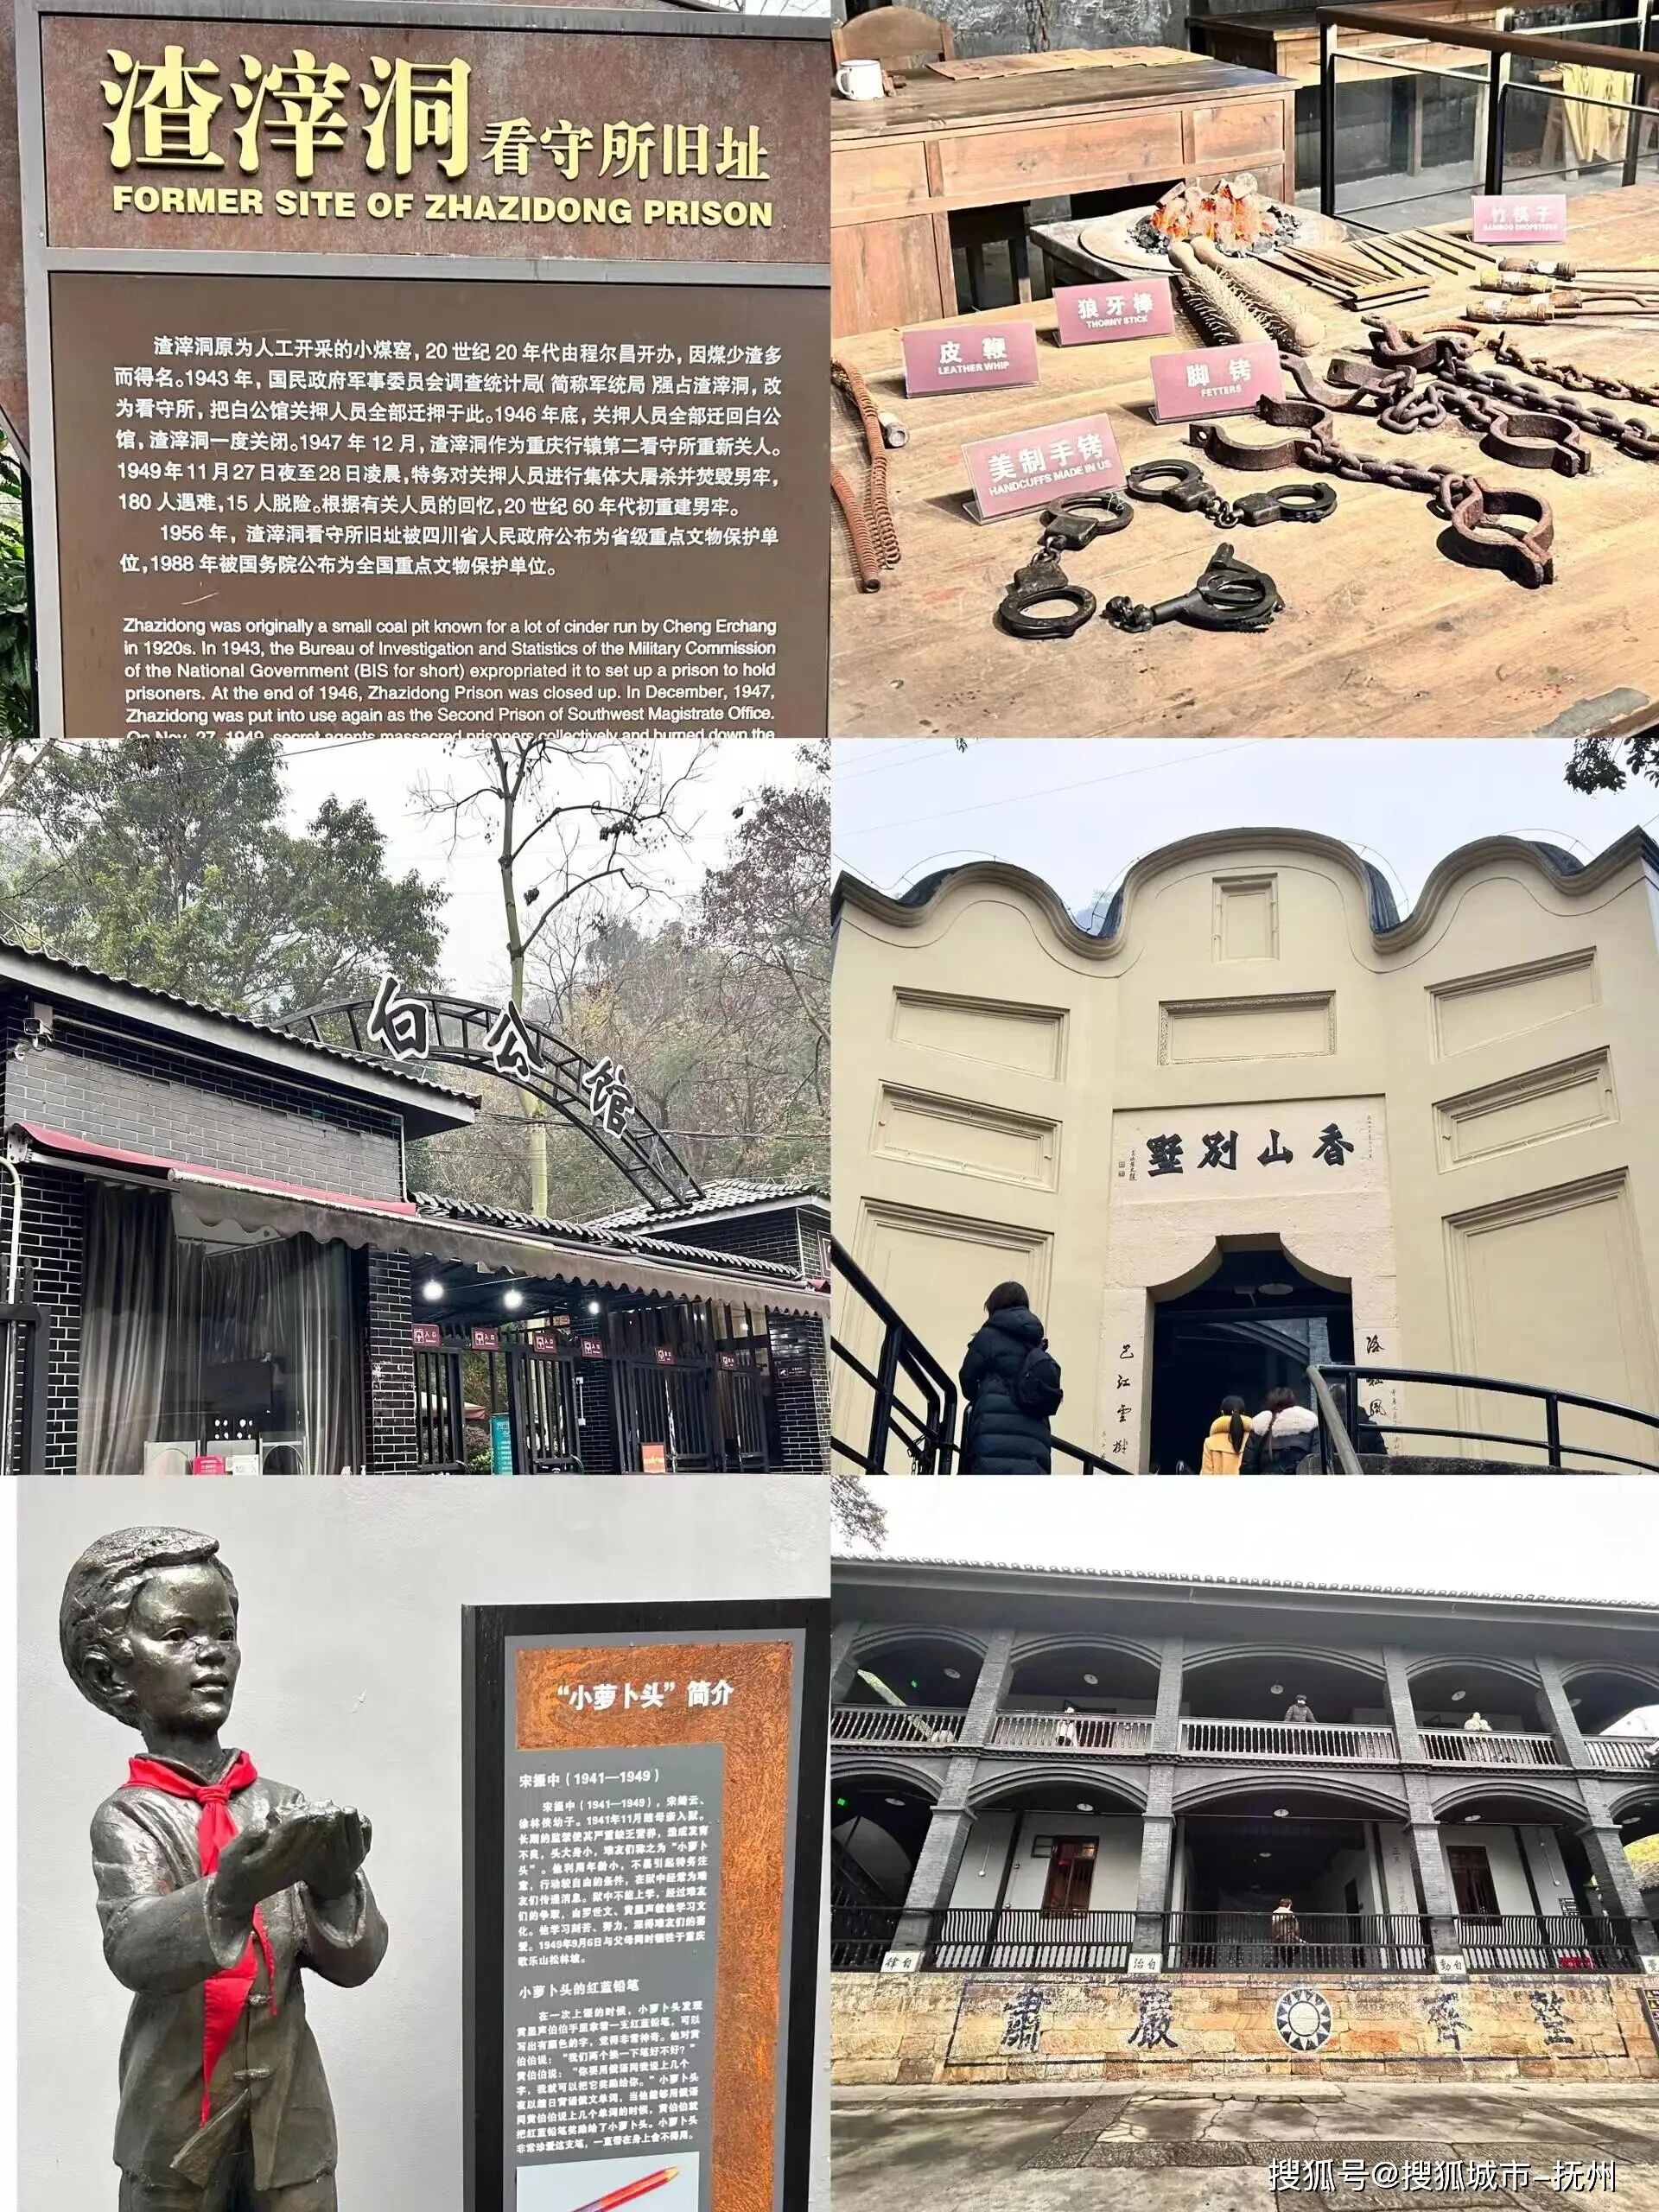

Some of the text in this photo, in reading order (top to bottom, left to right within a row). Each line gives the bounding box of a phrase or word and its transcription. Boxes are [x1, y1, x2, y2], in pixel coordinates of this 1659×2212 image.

[99, 44, 771, 181] 渣滓洞 看守所旧址
[113, 185, 773, 228] FORMER SITE OF ZHAZIDONG PRISON
[1078, 292, 1154, 319] 狼牙棒
[1086, 315, 1148, 328] THORNY STICK
[939, 337, 1008, 364] 皮鞭
[938, 360, 1010, 375] LEATHER WHIP
[1186, 358, 1251, 388] 脚铐
[1201, 385, 1243, 397] FETTERS
[988, 432, 1107, 483] 美制手铐
[988, 460, 1112, 497] HANDCUFFS MADE IN US
[123, 617, 777, 637] Zhazidong was originally a small coal pit known for a lot of cinder run by Cheng Erchang
[124, 640, 776, 659] in 1920s. In 1943, the Bureau of Investigation and Statistics of the Military Commission
[124, 662, 776, 681] of the National Government (BIS for short) expropriated it to set up a prison to hold
[124, 683, 775, 704] prisoners. At the end of 1946, Zhazidong Prison was closed up. In December, 1947,
[125, 705, 775, 726] Zhazidong was put into use again as the Second Prison of Southwest Magistrate Office.
[367, 976, 636, 1139] 白公馆
